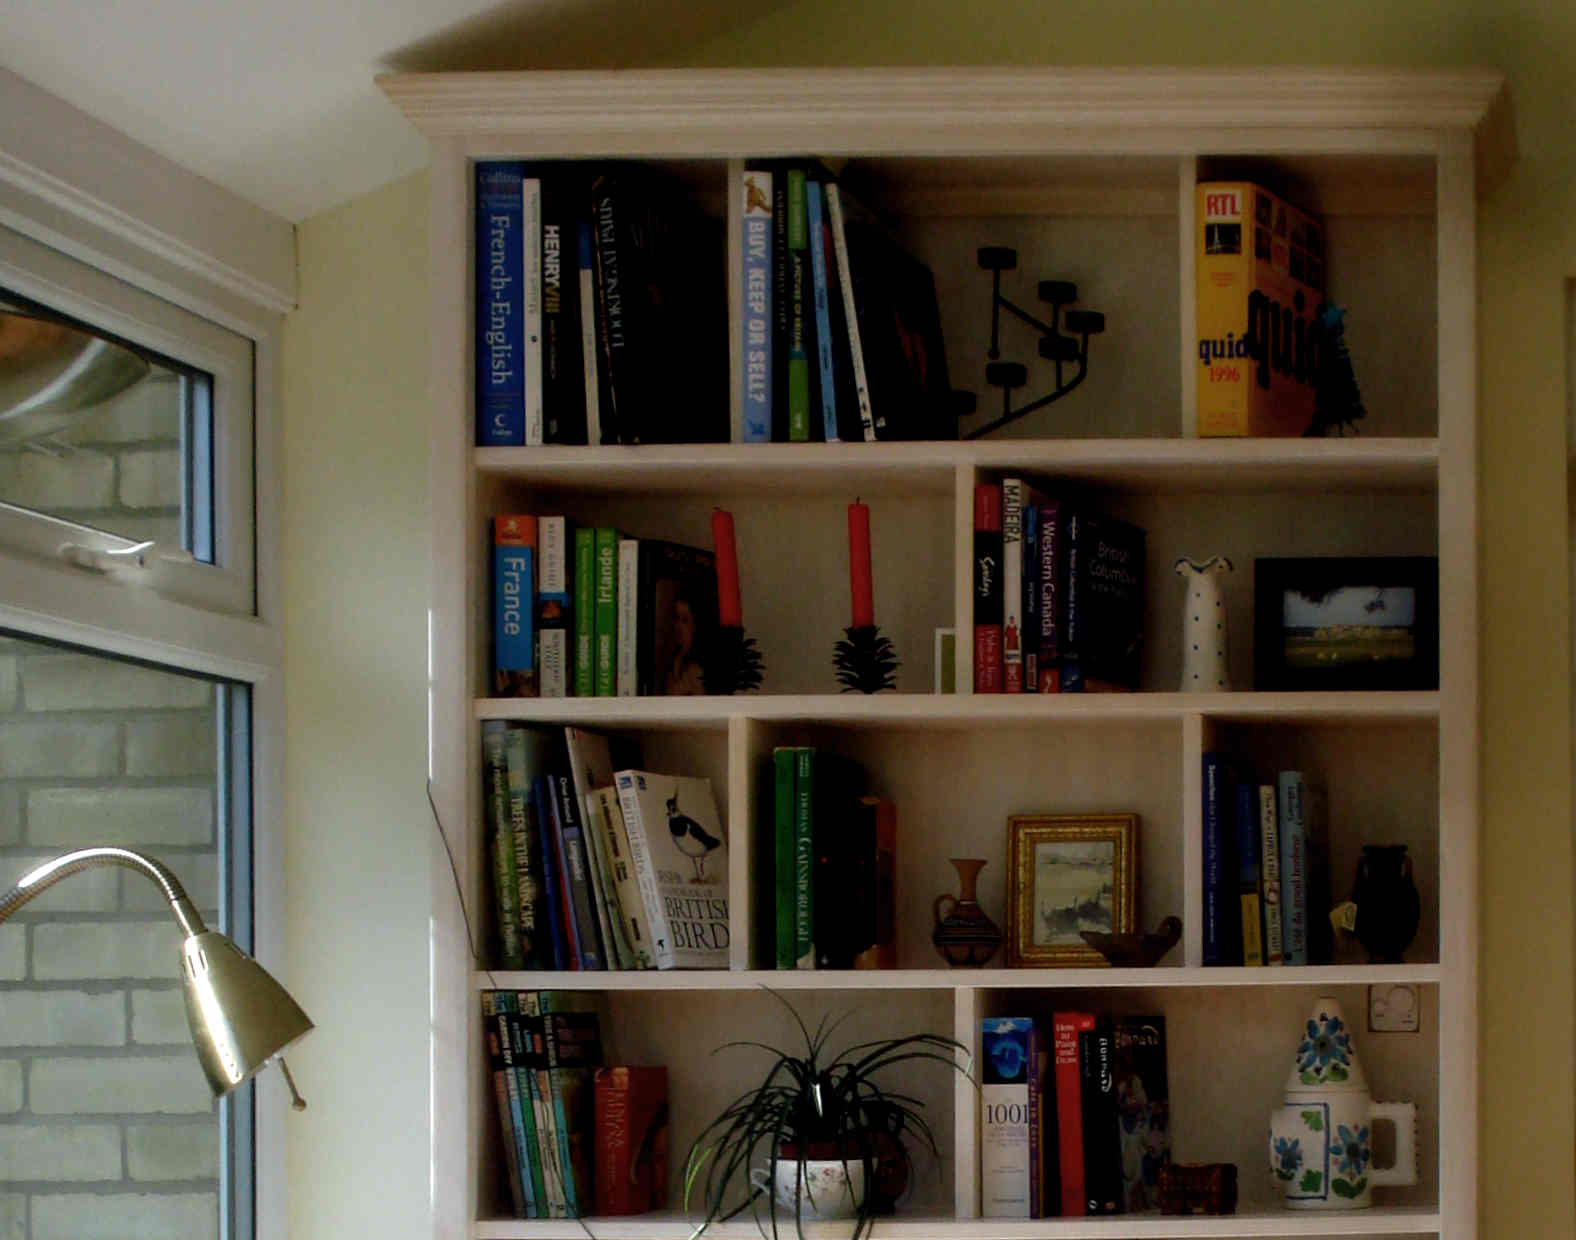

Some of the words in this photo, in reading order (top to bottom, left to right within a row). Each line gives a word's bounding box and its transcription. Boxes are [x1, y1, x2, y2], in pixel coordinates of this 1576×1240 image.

[1206, 194, 1240, 216] RTL
[745, 221, 766, 261] BUY,
[487, 213, 511, 385] French-English
[747, 267, 766, 313] KEEP
[747, 322, 766, 346] OR
[1199, 333, 1249, 365] quid
[748, 350, 767, 404] SELL?
[1208, 366, 1240, 384] 1996
[1003, 485, 1021, 543] MADEIRA
[1041, 520, 1057, 579] Western
[503, 556, 526, 636] France
[597, 547, 613, 603] Irlande
[1041, 582, 1057, 637] Canada
[510, 797, 527, 833] TREES
[514, 868, 536, 930] LANDSCAPE
[987, 1103, 1029, 1124] 1001
